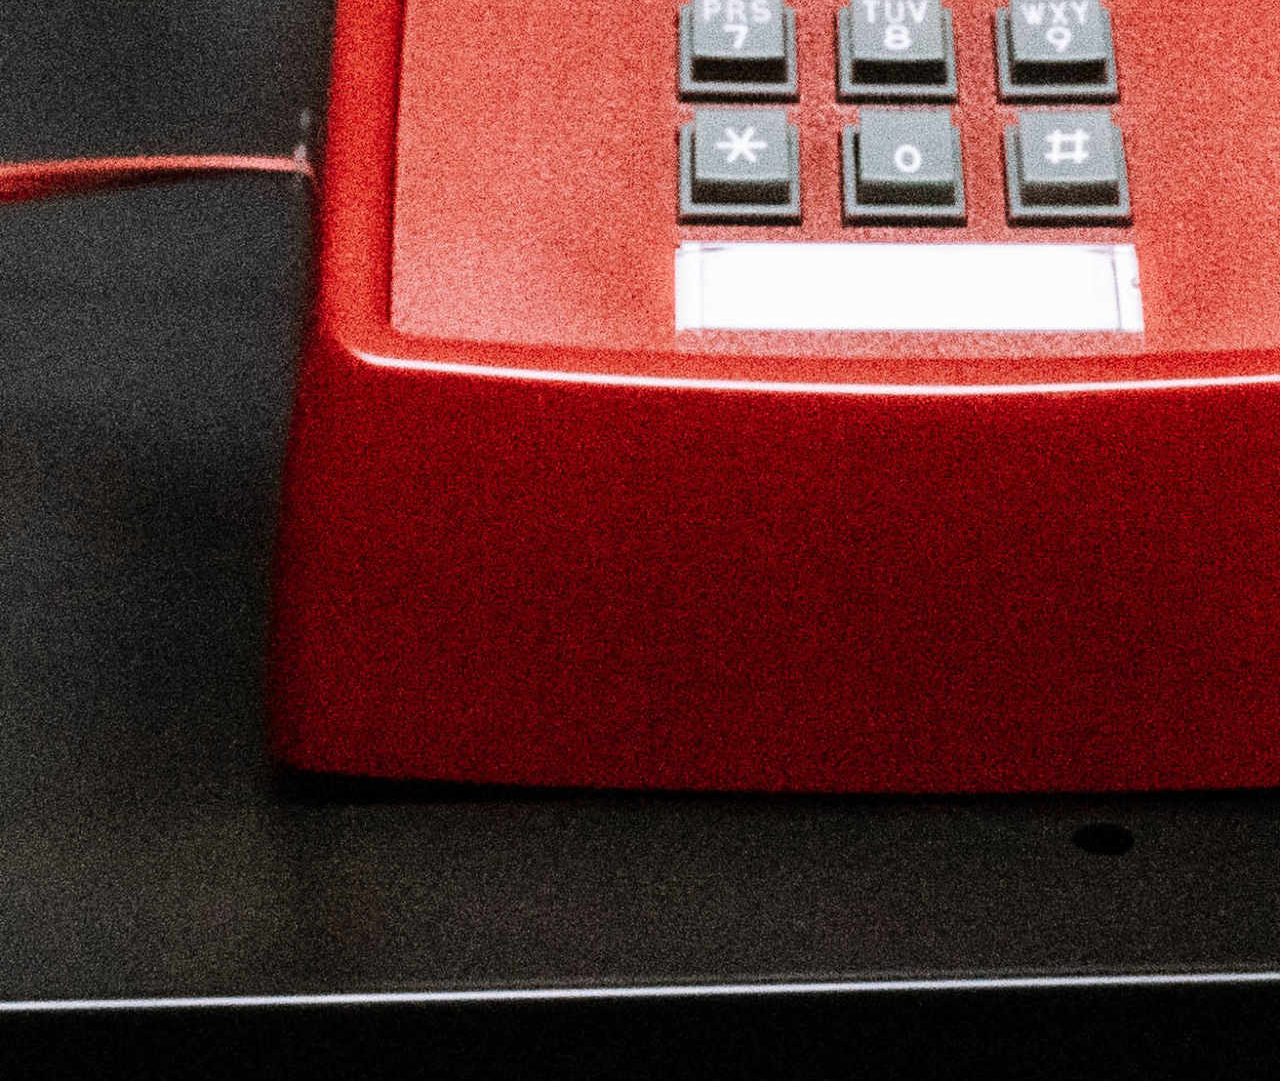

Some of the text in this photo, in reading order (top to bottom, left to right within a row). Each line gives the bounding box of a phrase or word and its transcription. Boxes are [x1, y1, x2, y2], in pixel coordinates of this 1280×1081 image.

[702, 0, 771, 23] PRS
[863, 0, 928, 23] TUV
[1021, 0, 1090, 24] WXY
[723, 23, 748, 50] 7
[883, 23, 910, 50] 8
[1045, 24, 1072, 52] 9
[1043, 128, 1091, 164] #
